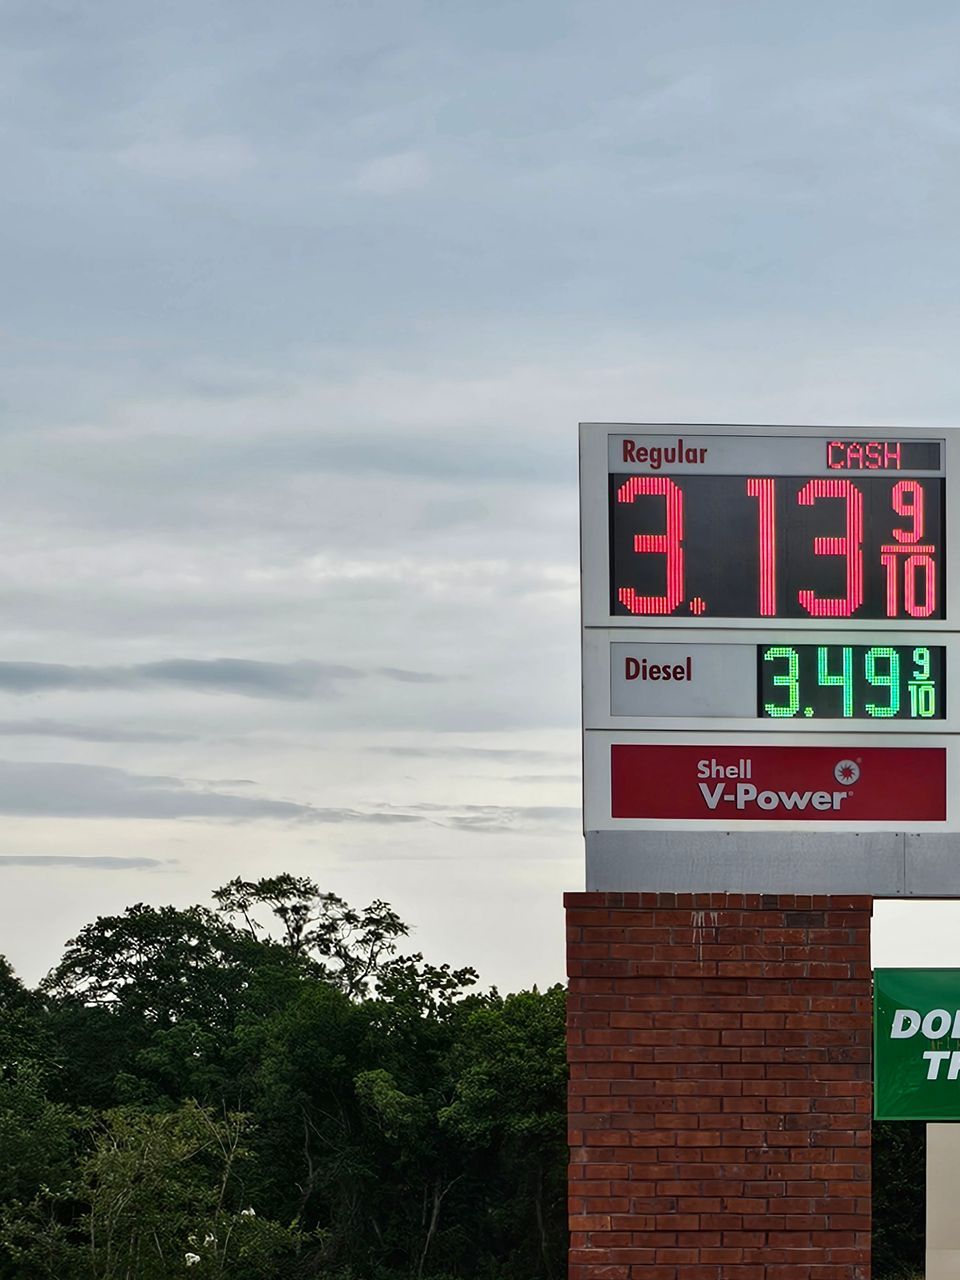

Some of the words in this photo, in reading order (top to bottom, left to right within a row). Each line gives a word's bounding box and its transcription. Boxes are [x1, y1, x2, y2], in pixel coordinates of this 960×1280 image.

[622, 439, 708, 469] Regular
[827, 441, 901, 470] CASH
[618, 477, 864, 617] 3.13
[625, 656, 692, 682] Diesel
[764, 646, 900, 717] 3.49
[697, 759, 752, 779] Shell
[698, 783, 848, 810] V-Power
